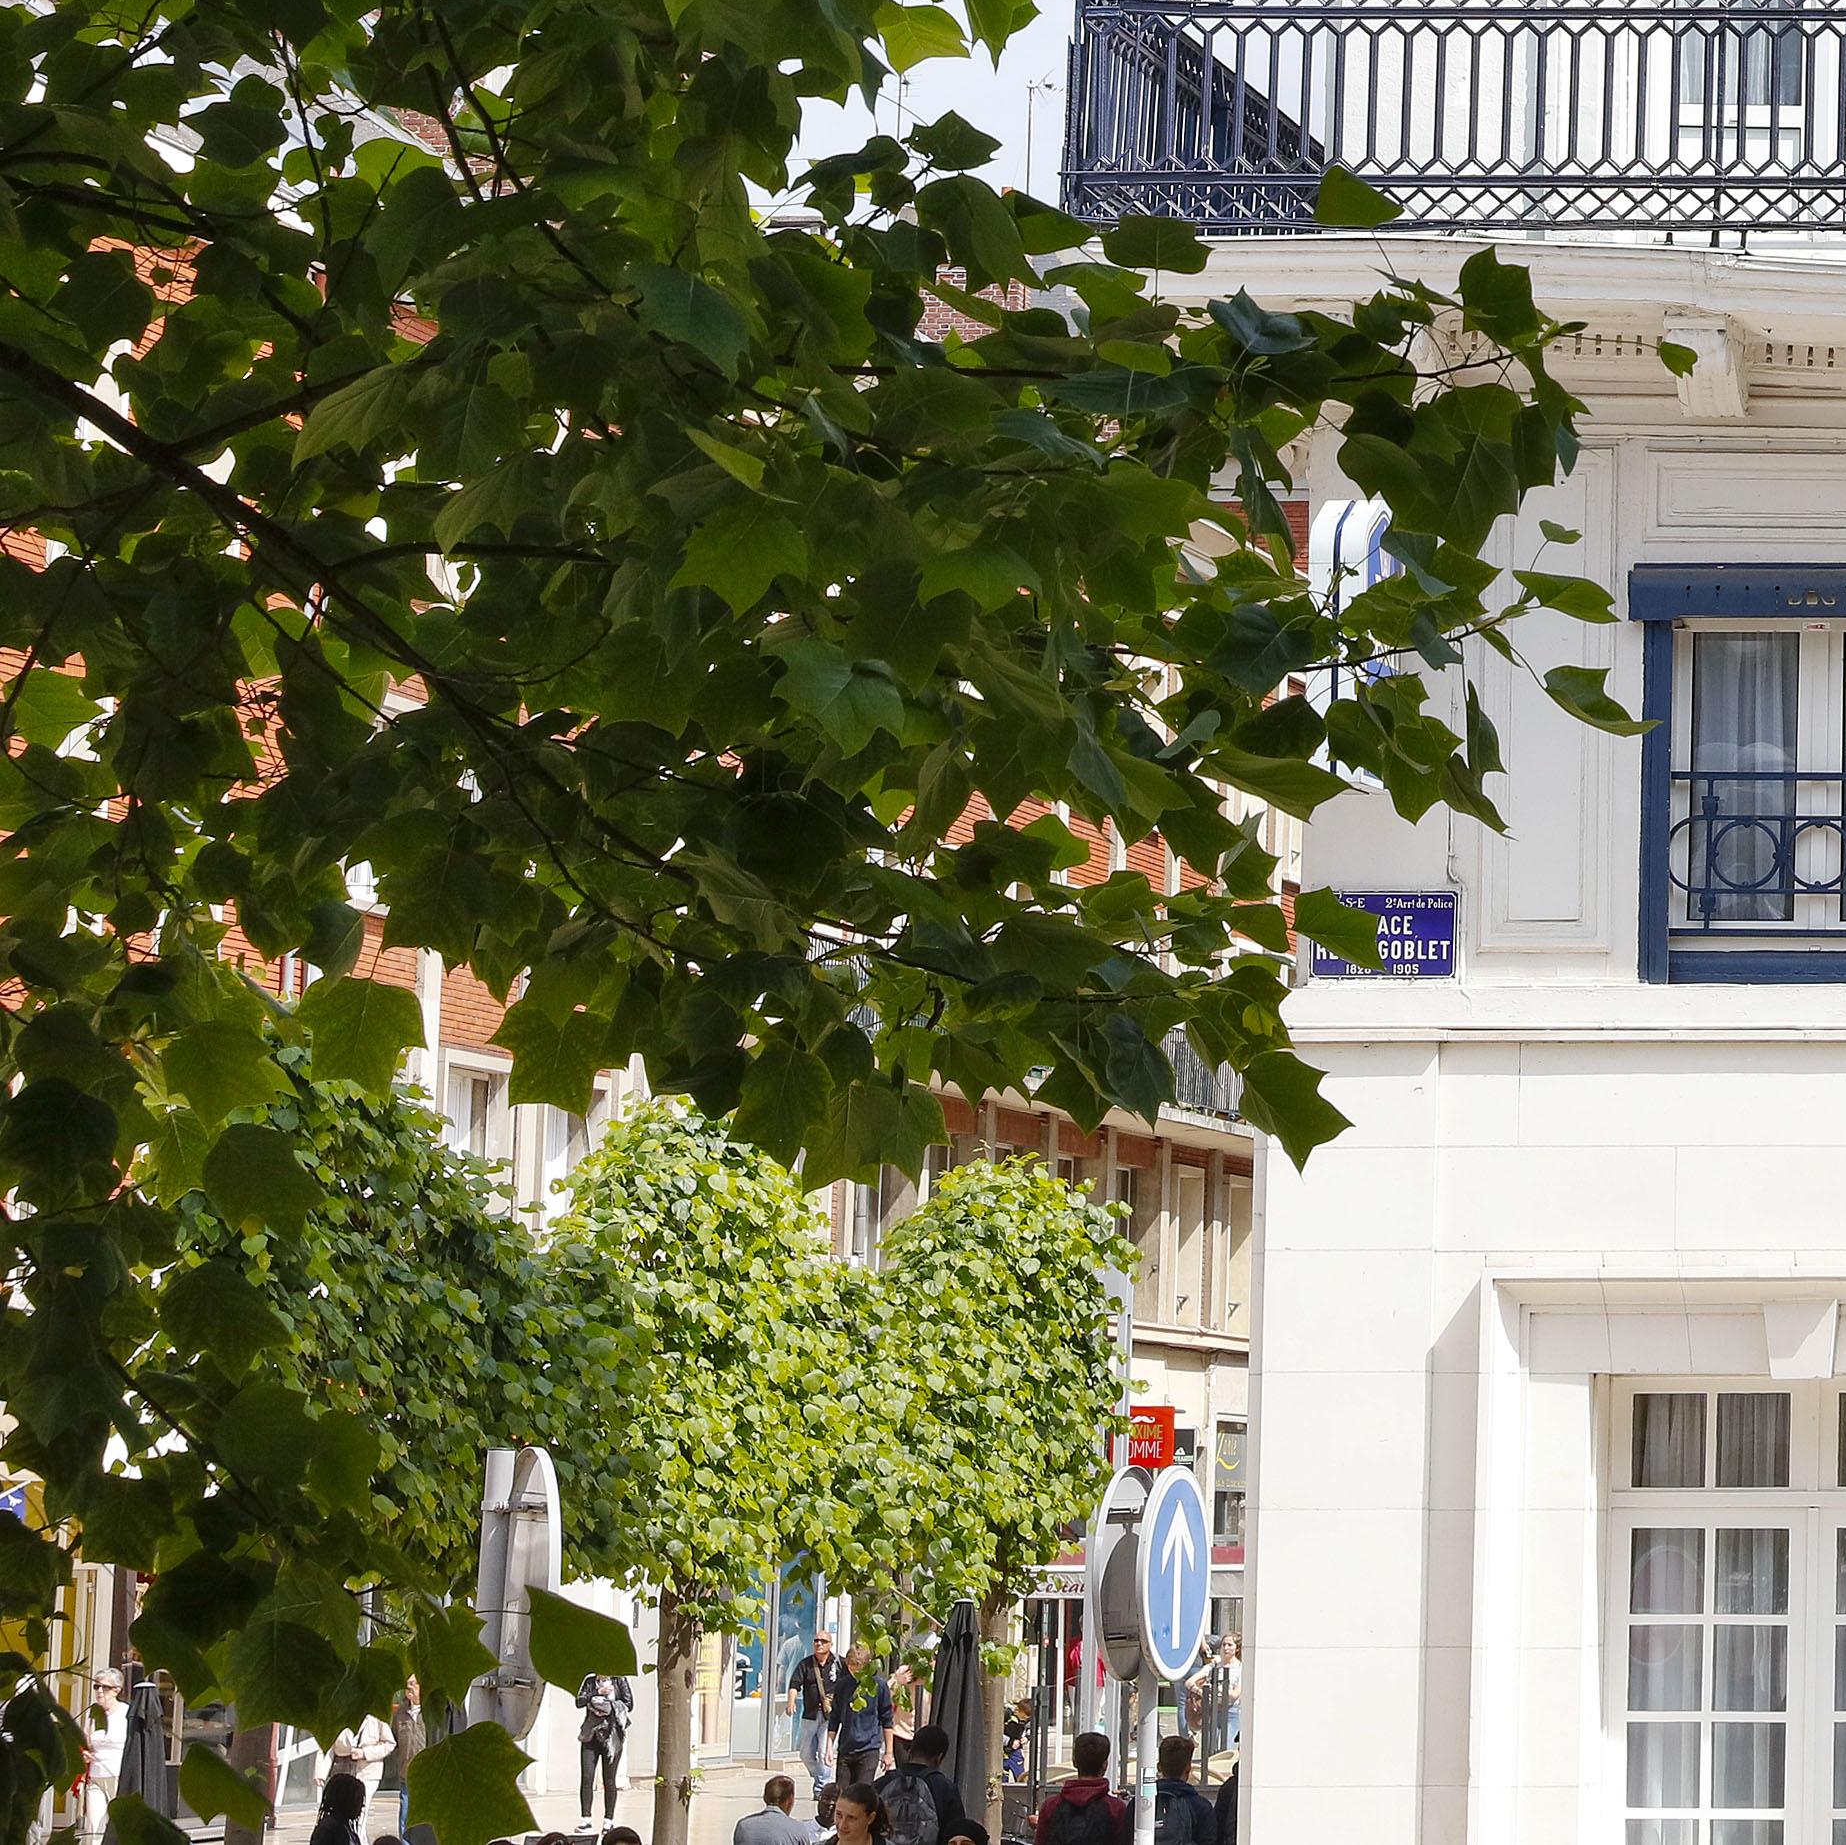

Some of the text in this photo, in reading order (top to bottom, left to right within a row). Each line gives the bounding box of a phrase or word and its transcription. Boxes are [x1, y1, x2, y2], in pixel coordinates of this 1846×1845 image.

[1416, 898, 1426, 909] de
[1427, 897, 1453, 909] Police
[1377, 915, 1414, 935] ACE
[1378, 940, 1451, 960] GOBLET
[1393, 964, 1419, 974] 1905
